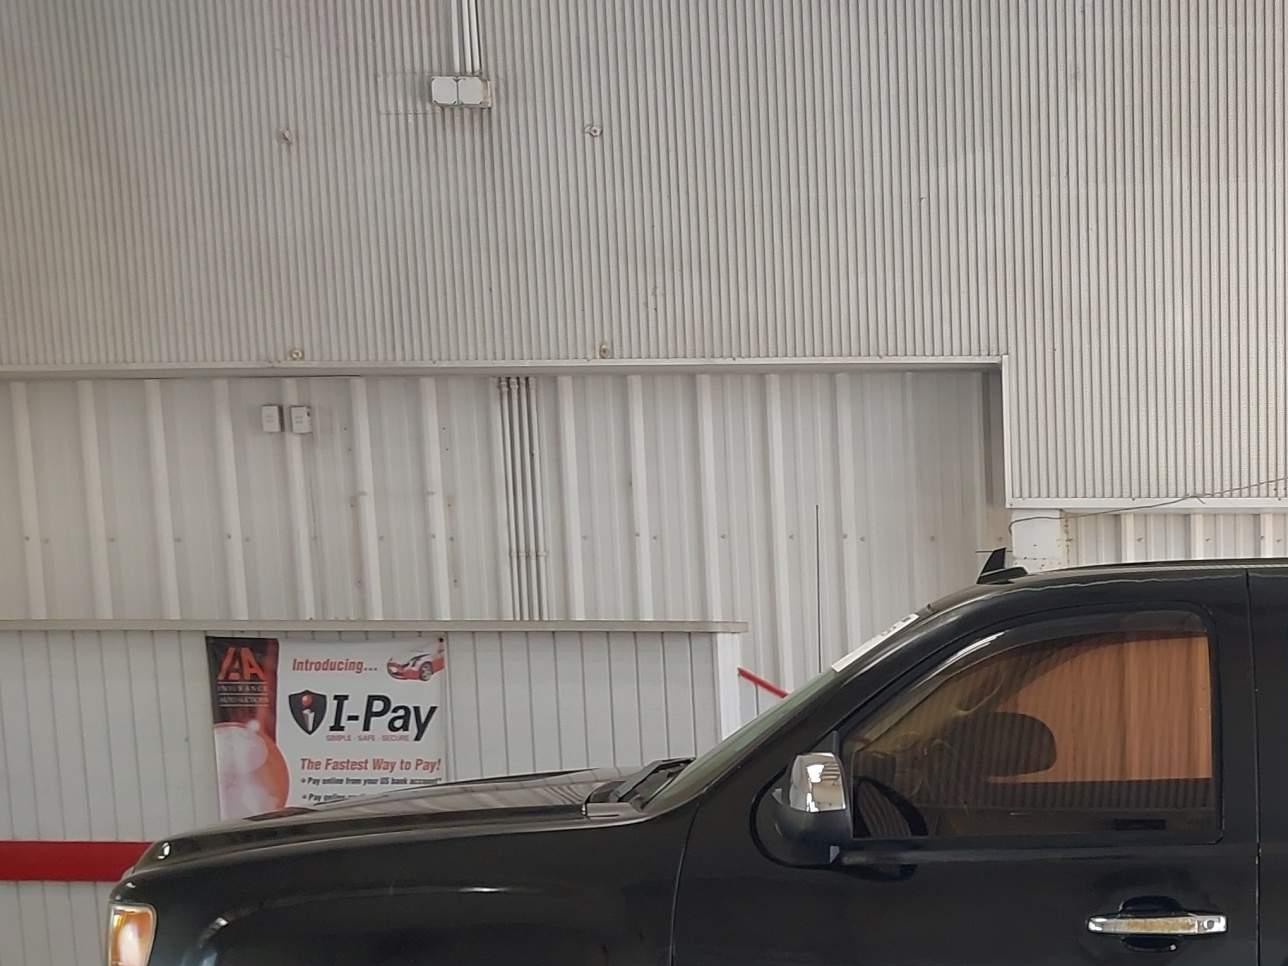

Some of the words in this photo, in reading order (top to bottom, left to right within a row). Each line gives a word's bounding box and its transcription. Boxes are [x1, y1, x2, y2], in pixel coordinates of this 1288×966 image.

[292, 658, 378, 674] Introducing...
[329, 694, 438, 742] I-Pay
[300, 758, 321, 770] The
[325, 758, 369, 770] Fastest
[372, 758, 397, 773] Way
[400, 759, 411, 770] to
[415, 758, 442, 773] Pay!
[307, 777, 321, 785] Pay
[308, 793, 322, 802] Pay
